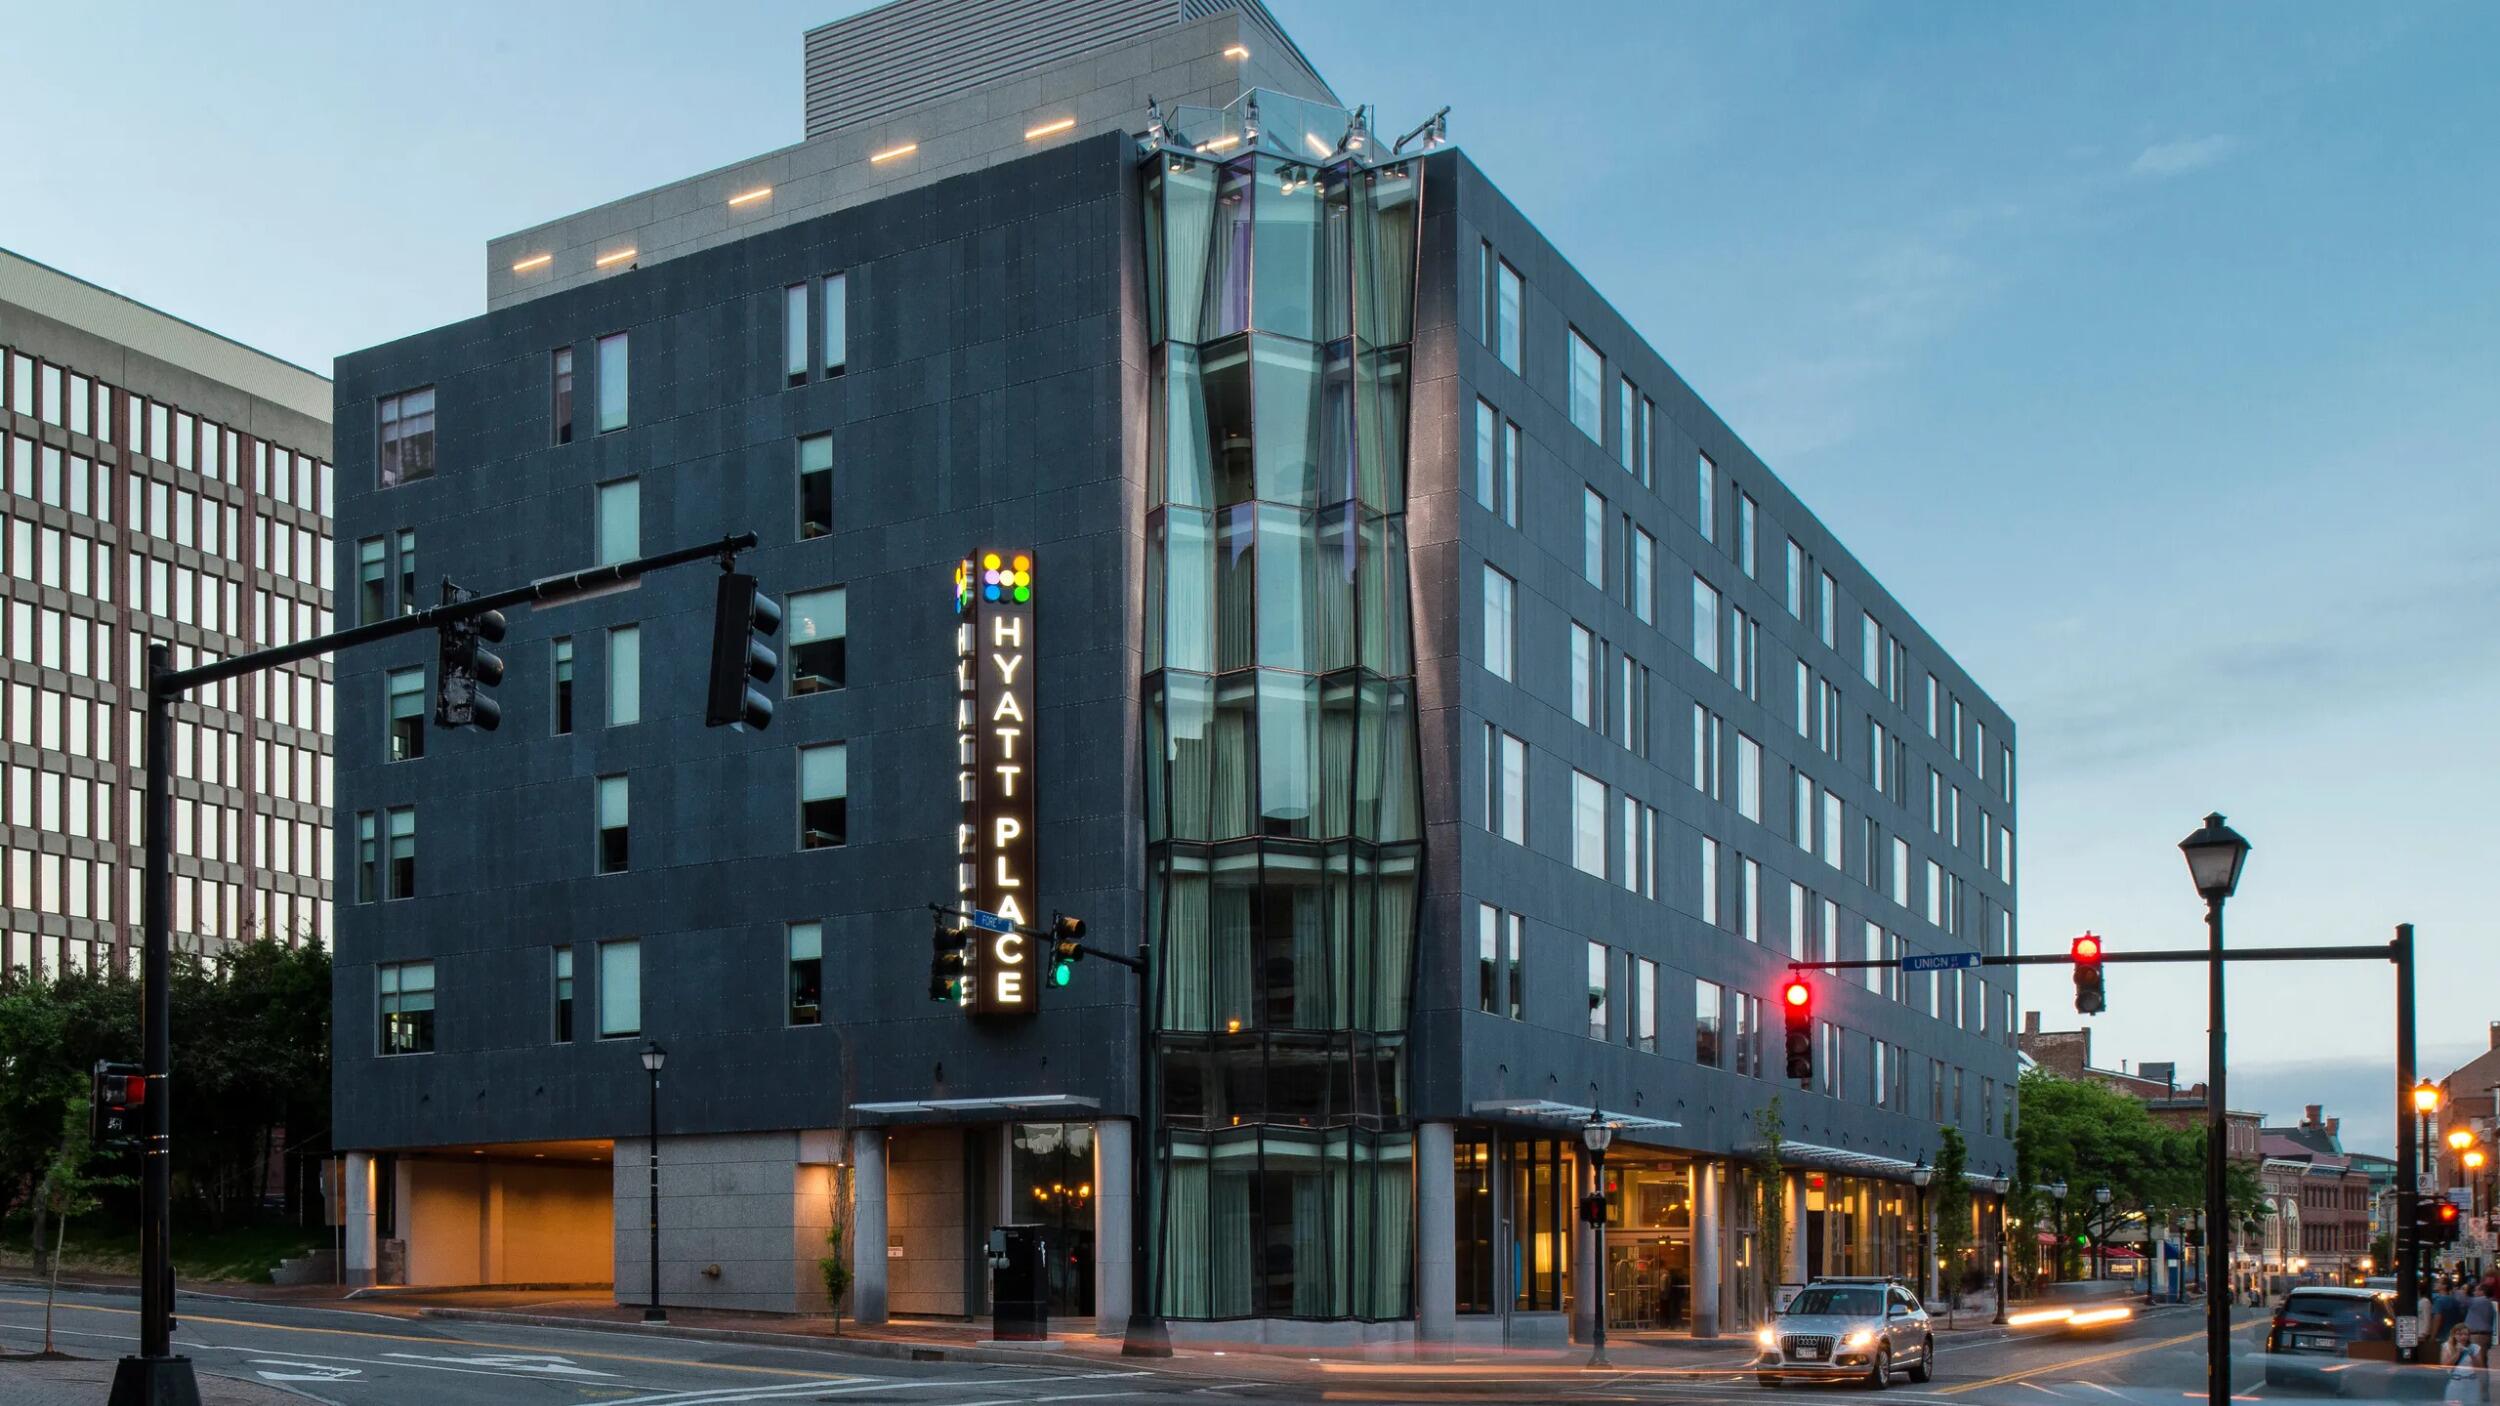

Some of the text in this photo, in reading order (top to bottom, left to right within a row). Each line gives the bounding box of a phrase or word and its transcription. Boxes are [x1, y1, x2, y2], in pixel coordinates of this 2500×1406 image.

[993, 615, 1026, 1003] HYATT PLACE
[1914, 957, 1948, 969] UNION
